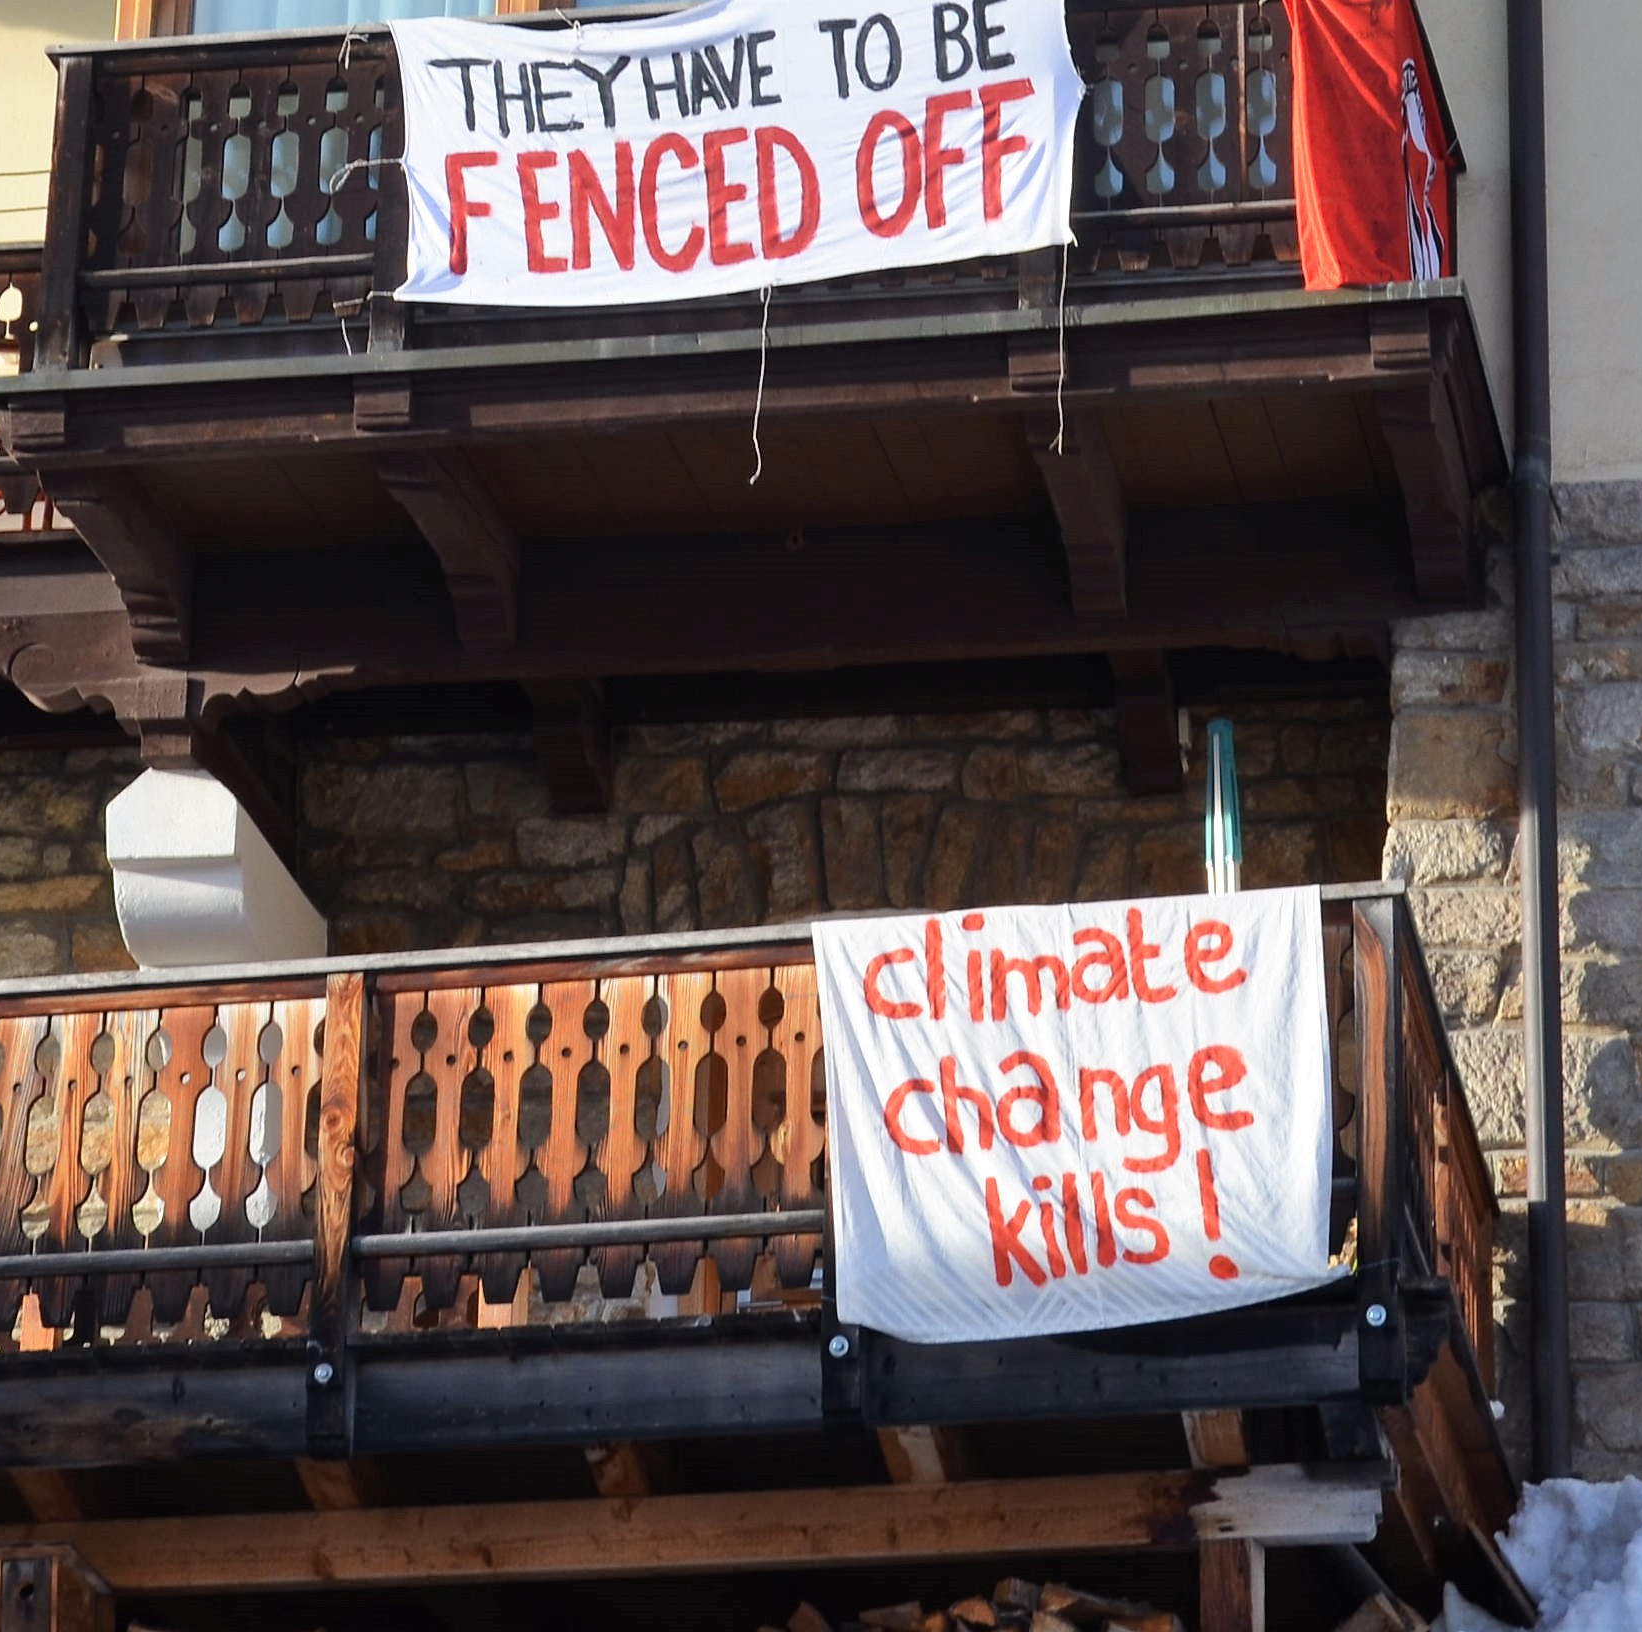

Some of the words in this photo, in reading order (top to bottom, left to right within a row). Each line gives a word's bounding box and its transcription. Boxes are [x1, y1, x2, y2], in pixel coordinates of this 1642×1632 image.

[427, 53, 631, 137] THEY
[640, 30, 782, 120] HAVE
[819, 13, 902, 98] TO
[445, 126, 820, 276] FENCED
[856, 77, 1035, 238] OFF
[863, 907, 1247, 1023] climate
[883, 1044, 1254, 1172] change
[985, 1148, 1240, 1287] kills!
